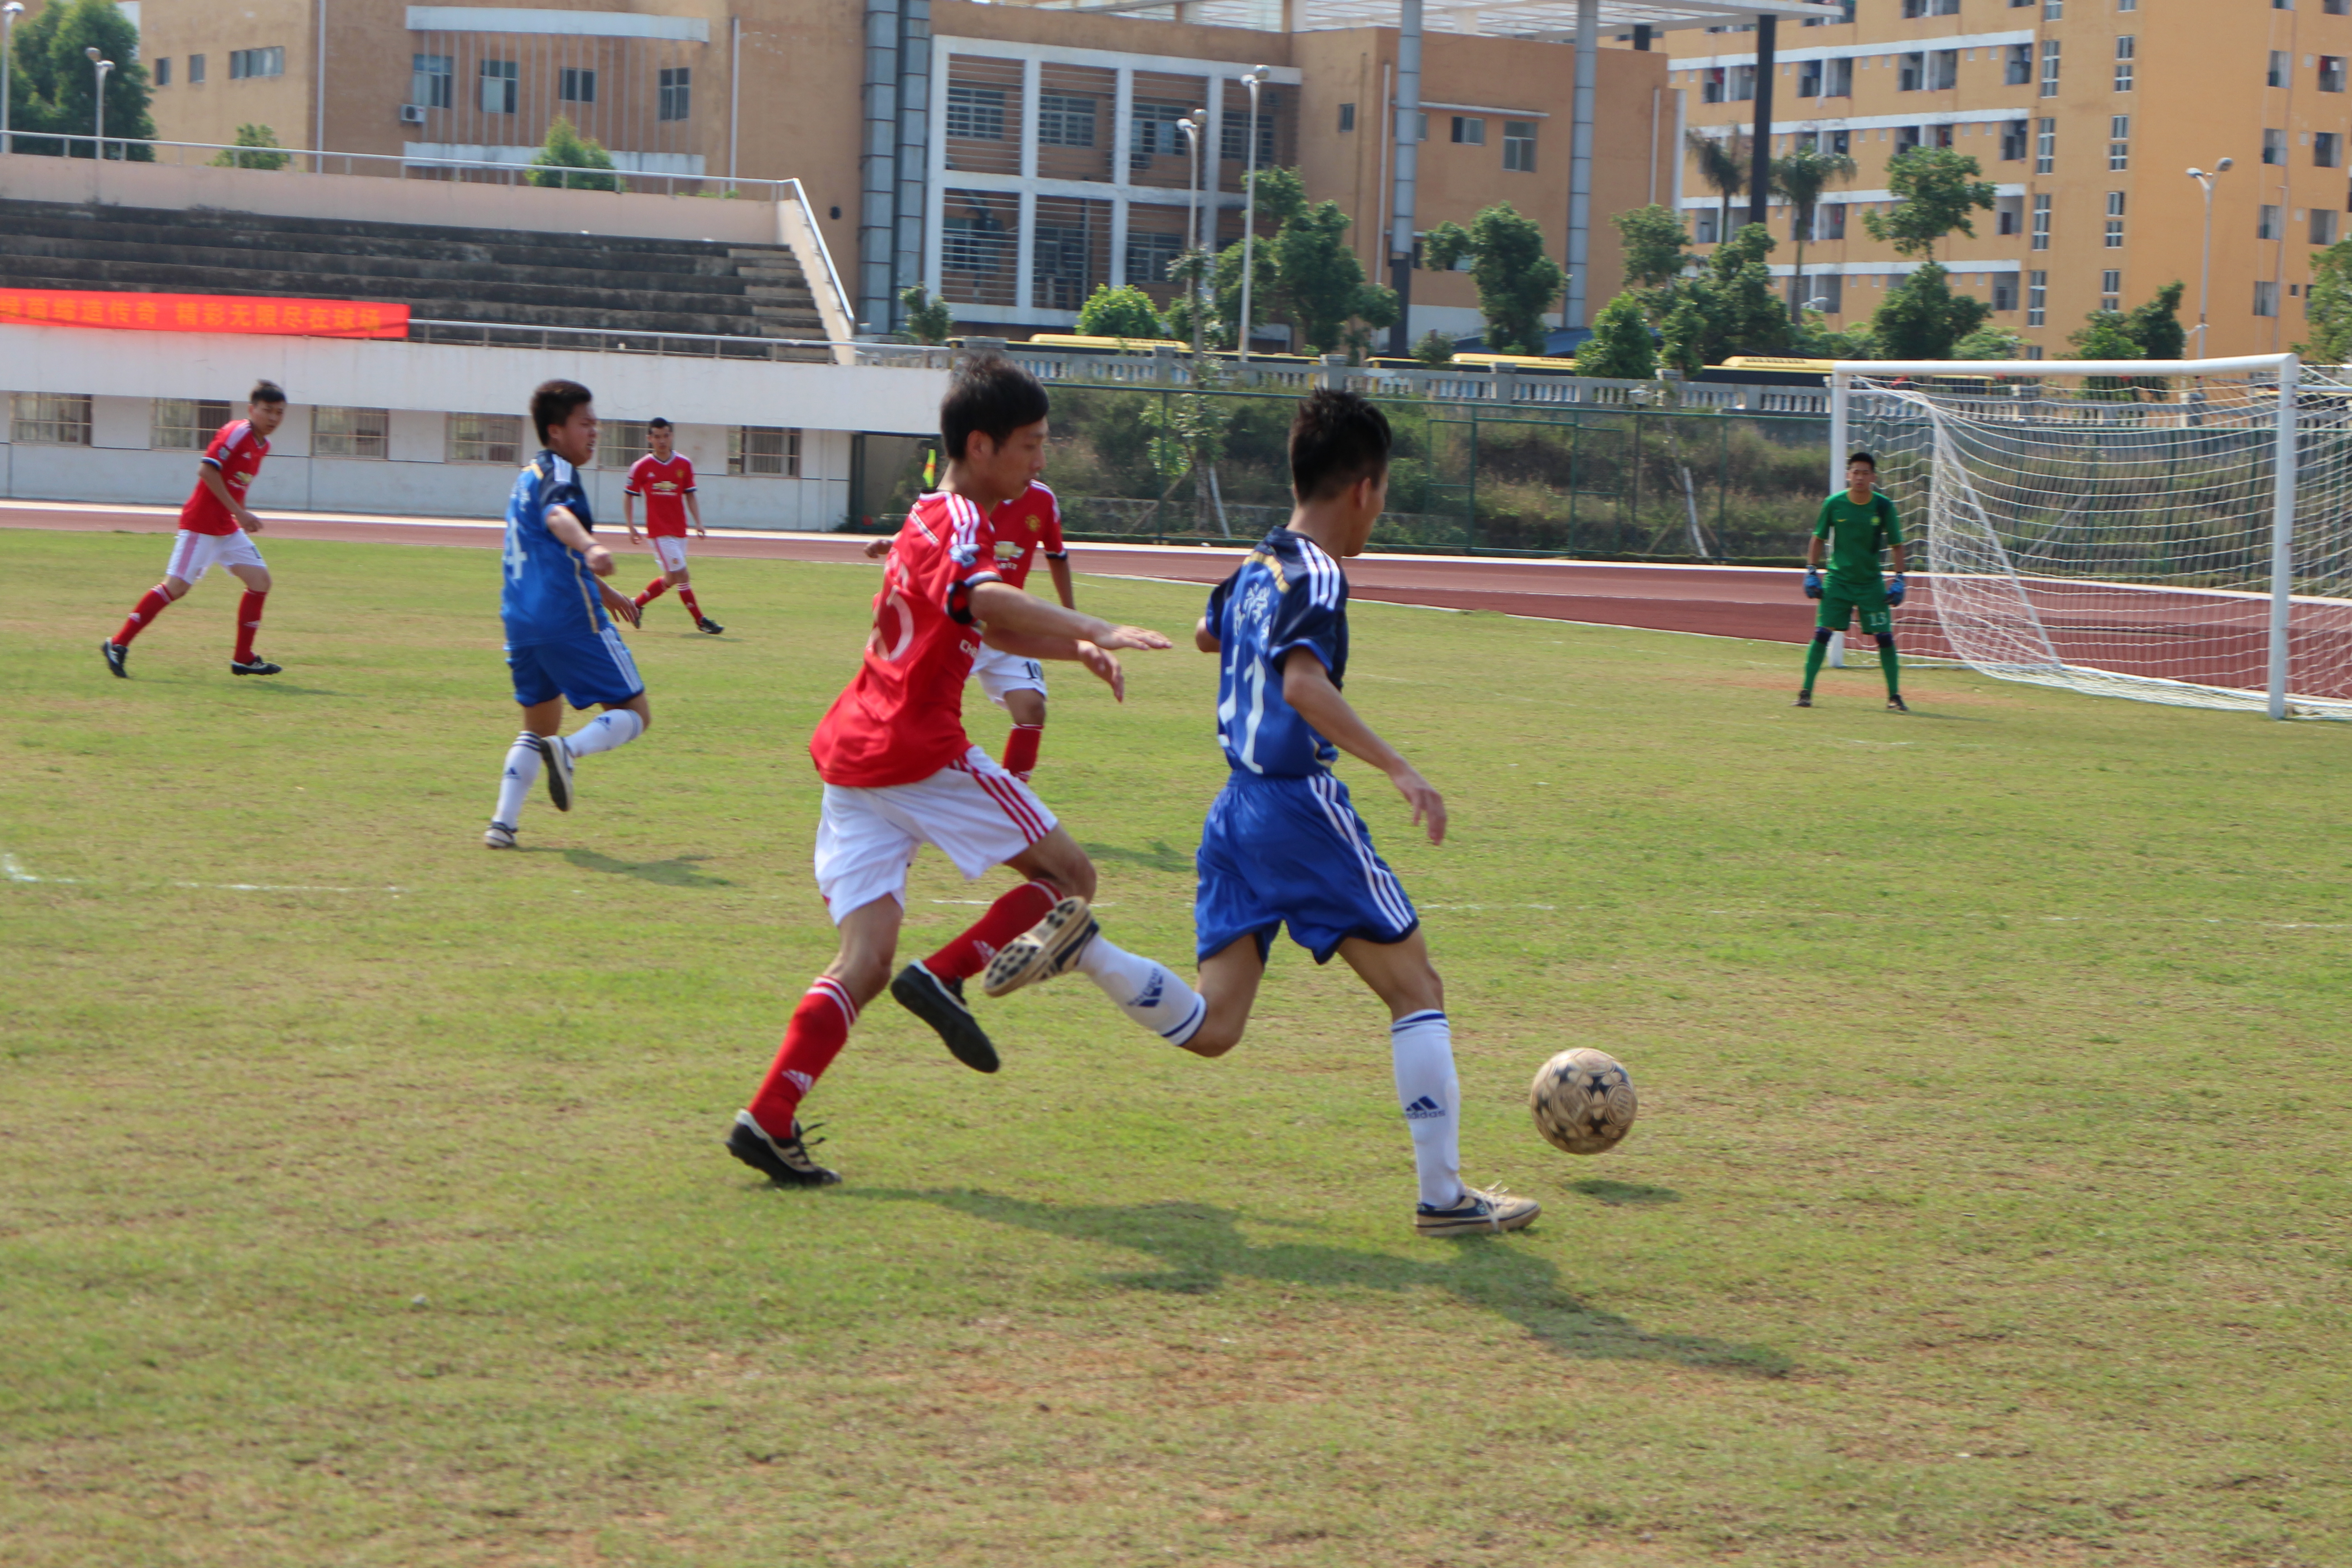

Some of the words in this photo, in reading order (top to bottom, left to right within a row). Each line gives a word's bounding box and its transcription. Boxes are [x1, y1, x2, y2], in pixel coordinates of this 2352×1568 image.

[176, 301, 381, 331] 精彩无限尽在球场
[1406, 1109, 1446, 1120] adidas
